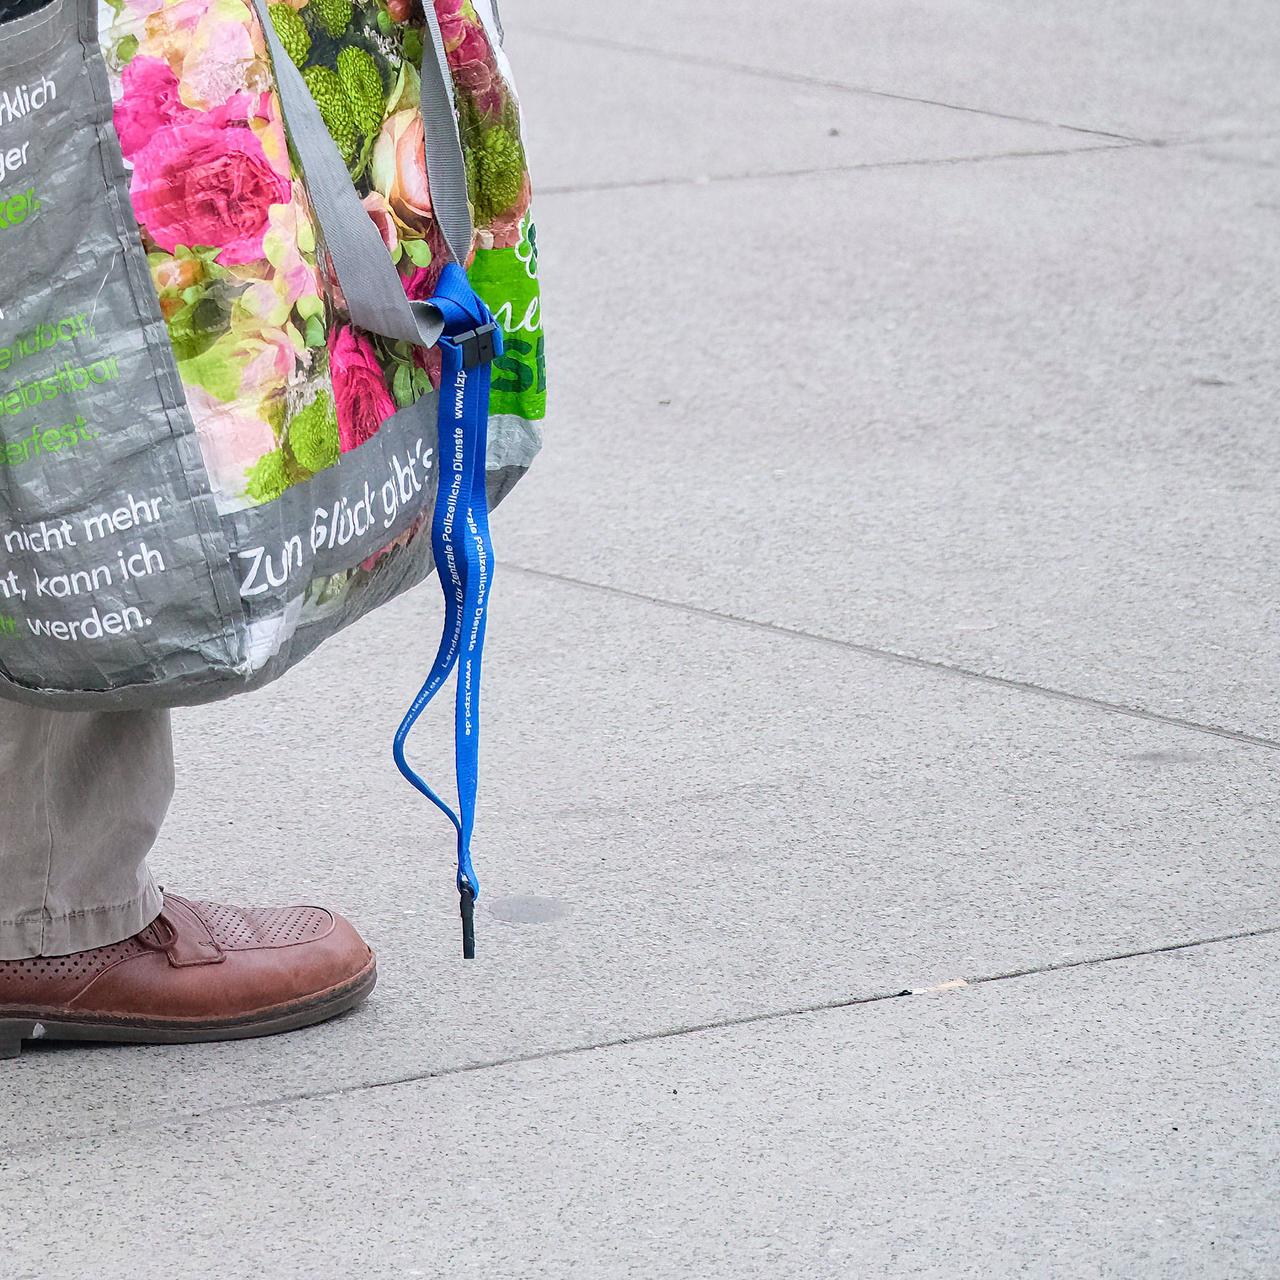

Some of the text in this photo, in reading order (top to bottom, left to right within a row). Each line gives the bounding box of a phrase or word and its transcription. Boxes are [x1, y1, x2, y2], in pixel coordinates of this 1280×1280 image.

[452, 427, 464, 472] Dienste
[4, 519, 76, 553] nicht
[84, 494, 162, 542] mehr
[442, 473, 463, 542] Polizeiliche
[33, 567, 113, 598] kann
[117, 542, 166, 581] ich
[473, 535, 488, 605] Polizeiliche
[26, 606, 153, 641] werden.
[468, 607, 484, 652] Dienste
